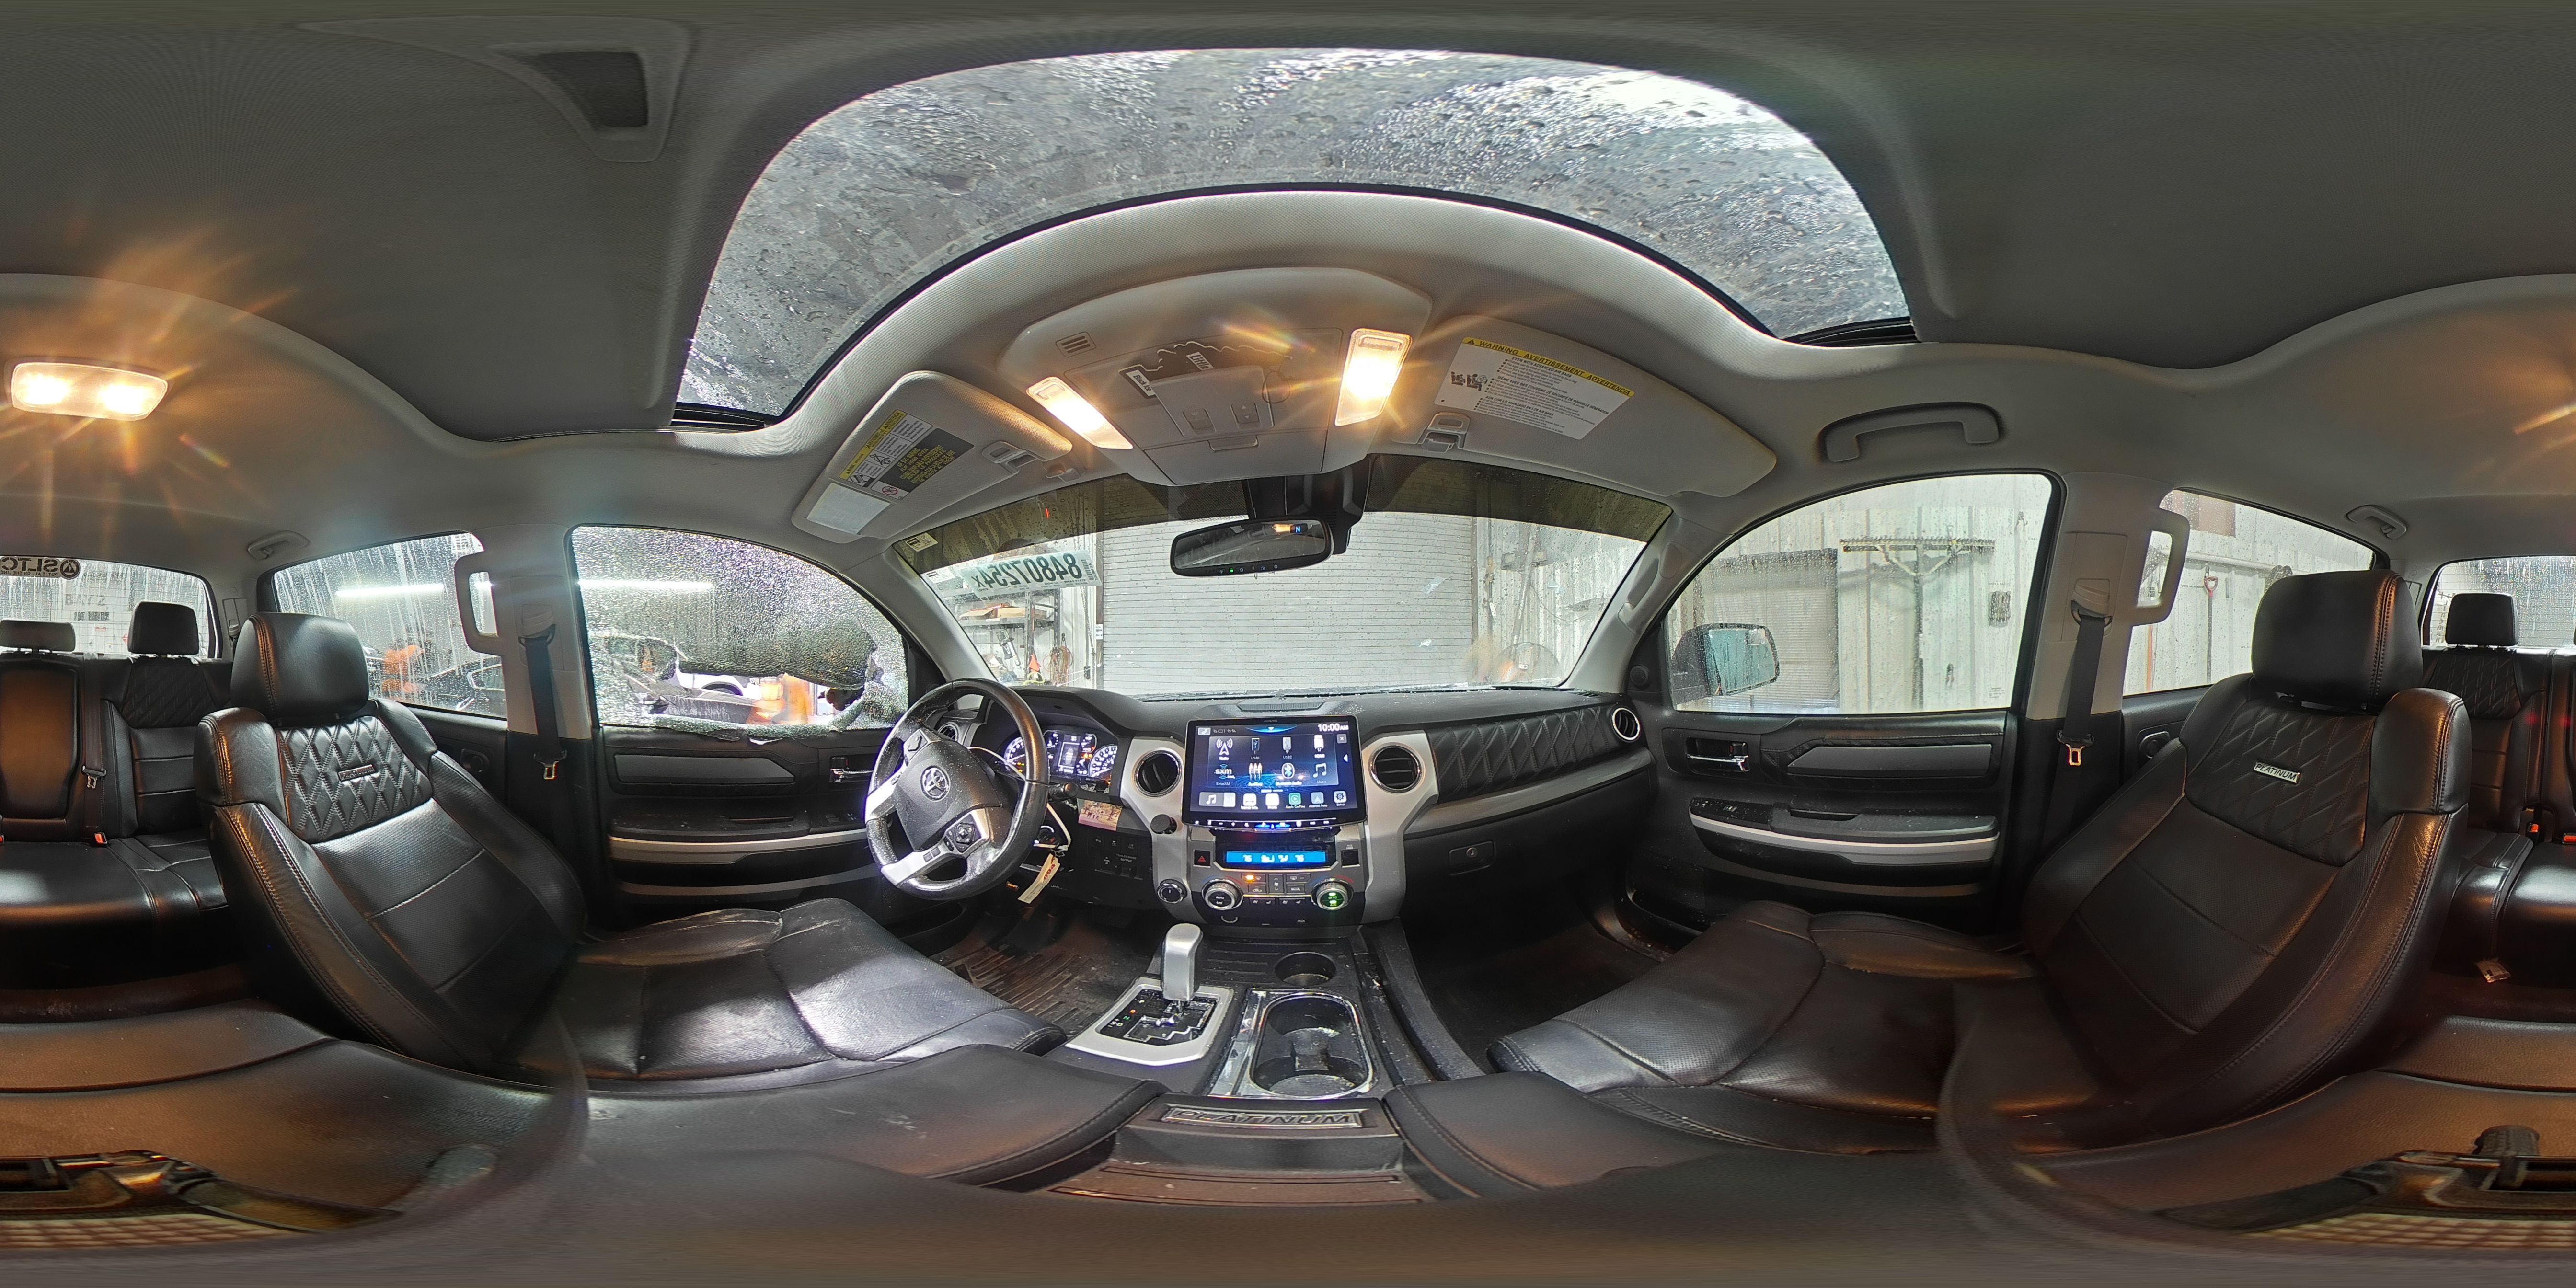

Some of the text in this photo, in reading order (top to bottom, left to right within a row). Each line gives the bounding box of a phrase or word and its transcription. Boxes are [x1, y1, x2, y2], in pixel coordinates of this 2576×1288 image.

[1190, 354, 1210, 369] Little
[1479, 340, 1519, 355] WARNING
[1523, 353, 1585, 377] AVERTISSEMENT
[1586, 374, 1631, 395] ADVERTENCIA
[1133, 375, 1147, 386] Black
[908, 456, 919, 465] VISOR
[918, 448, 928, 457] OVER
[2255, 763, 2297, 780] PLATINUM
[1173, 1110, 1353, 1125] PLATINUM
